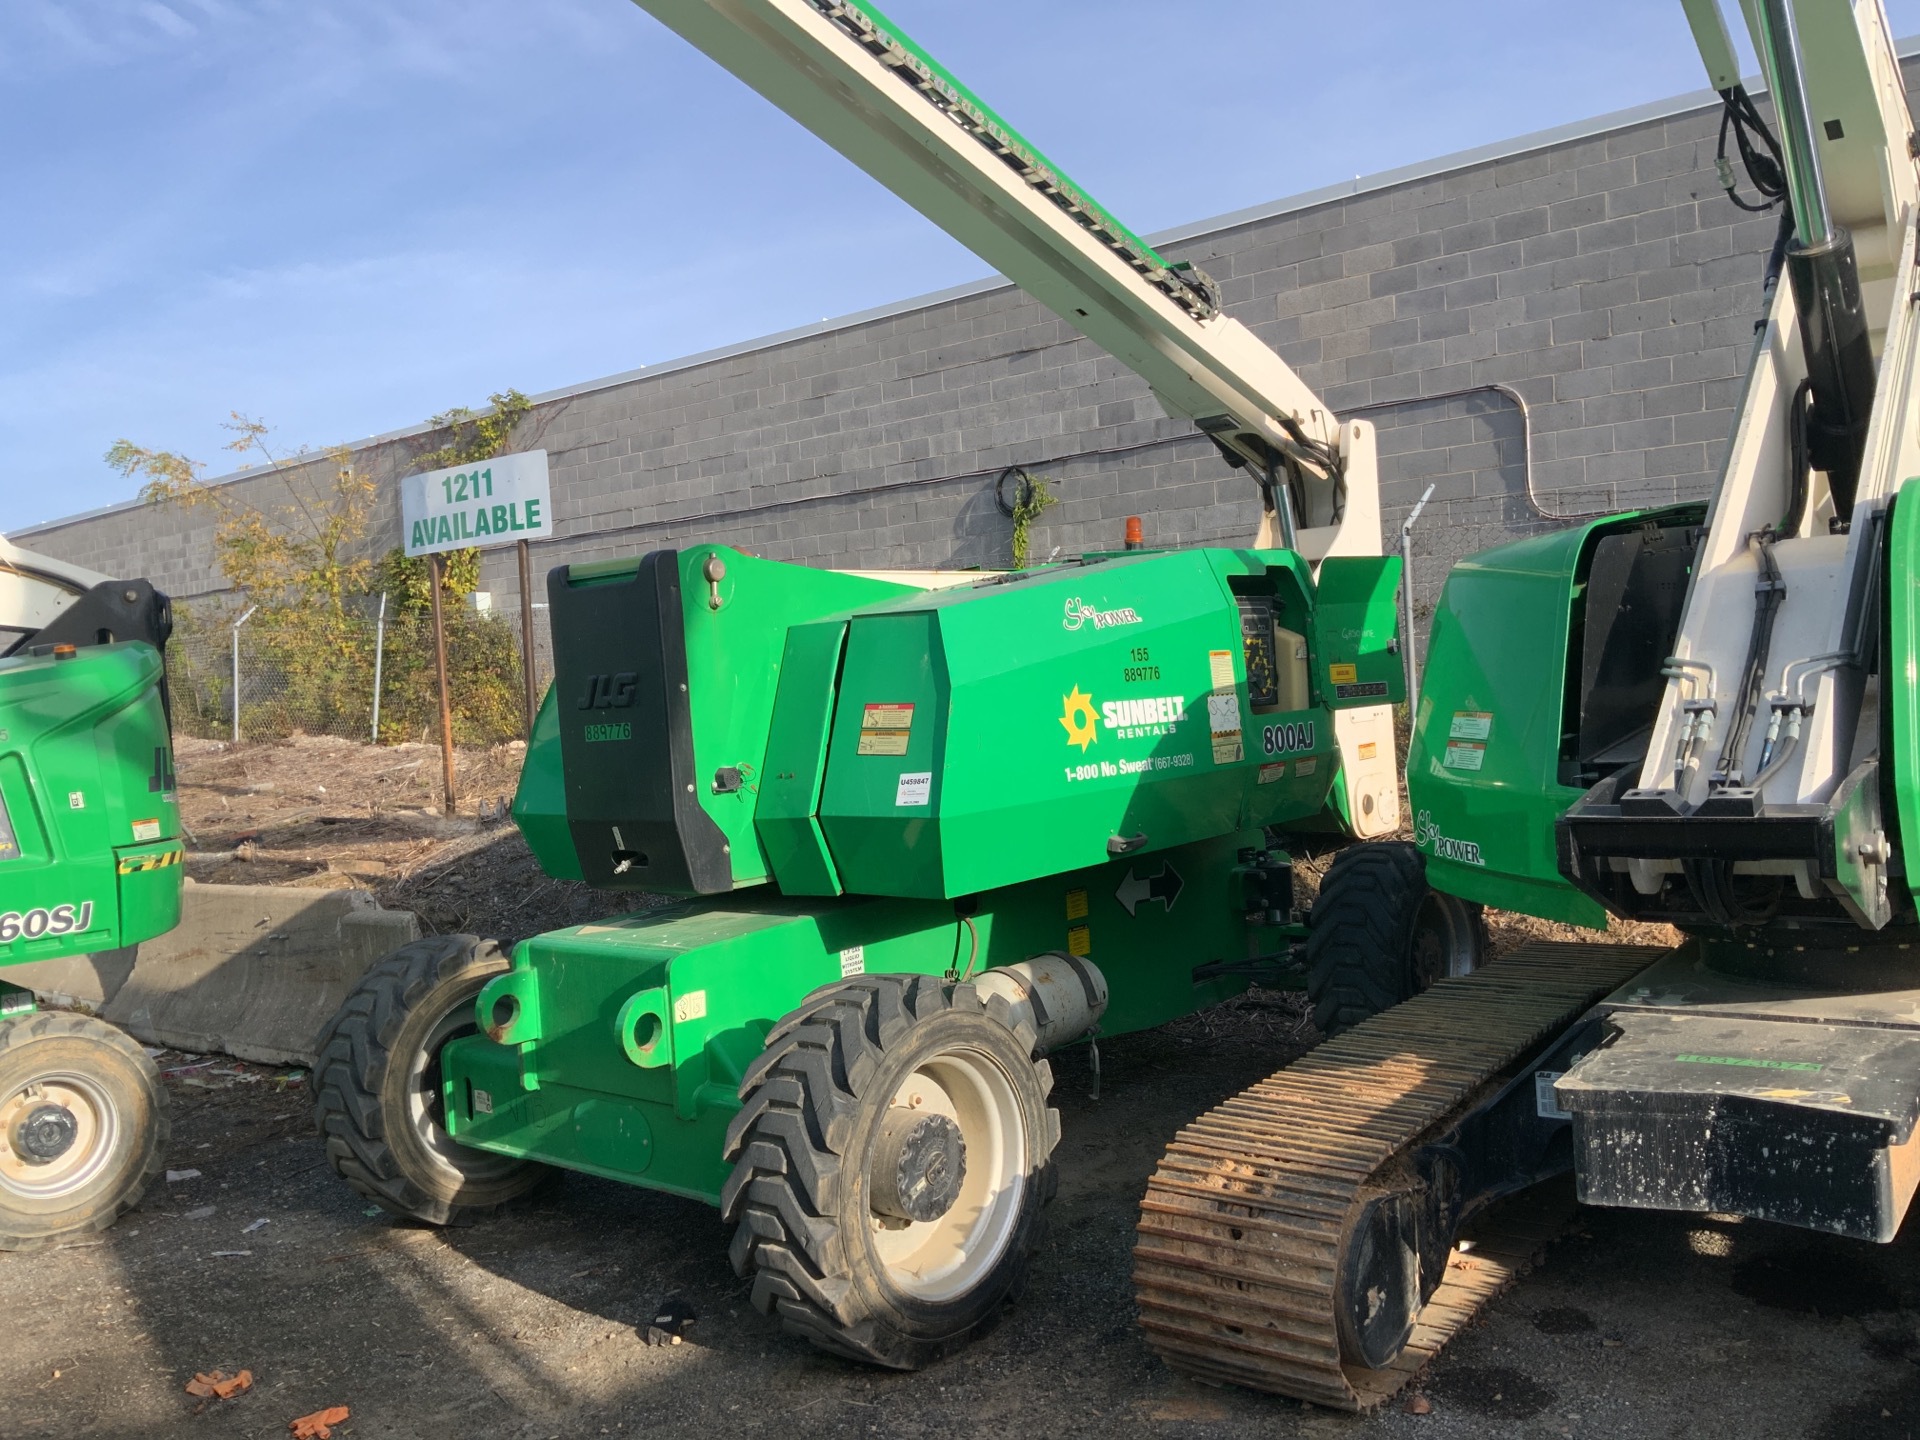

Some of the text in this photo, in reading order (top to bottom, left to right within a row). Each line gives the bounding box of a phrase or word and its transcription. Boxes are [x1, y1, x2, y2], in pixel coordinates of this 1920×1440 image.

[441, 468, 493, 504] 1211
[411, 499, 542, 549] AVAILABLE
[1096, 607, 1141, 629] POWER
[1131, 648, 1149, 662] 155
[1124, 666, 1161, 682] 889776
[578, 671, 639, 710] JLG
[1102, 696, 1185, 729] SUNBELT
[586, 723, 631, 741] 889776
[1117, 724, 1177, 739] RENTALS
[1263, 721, 1314, 755] 800AJ
[900, 777, 930, 786] U459847
[1065, 753, 1194, 782] 1-800 No Sweat (667-9328)
[1437, 836, 1481, 866] POWER
